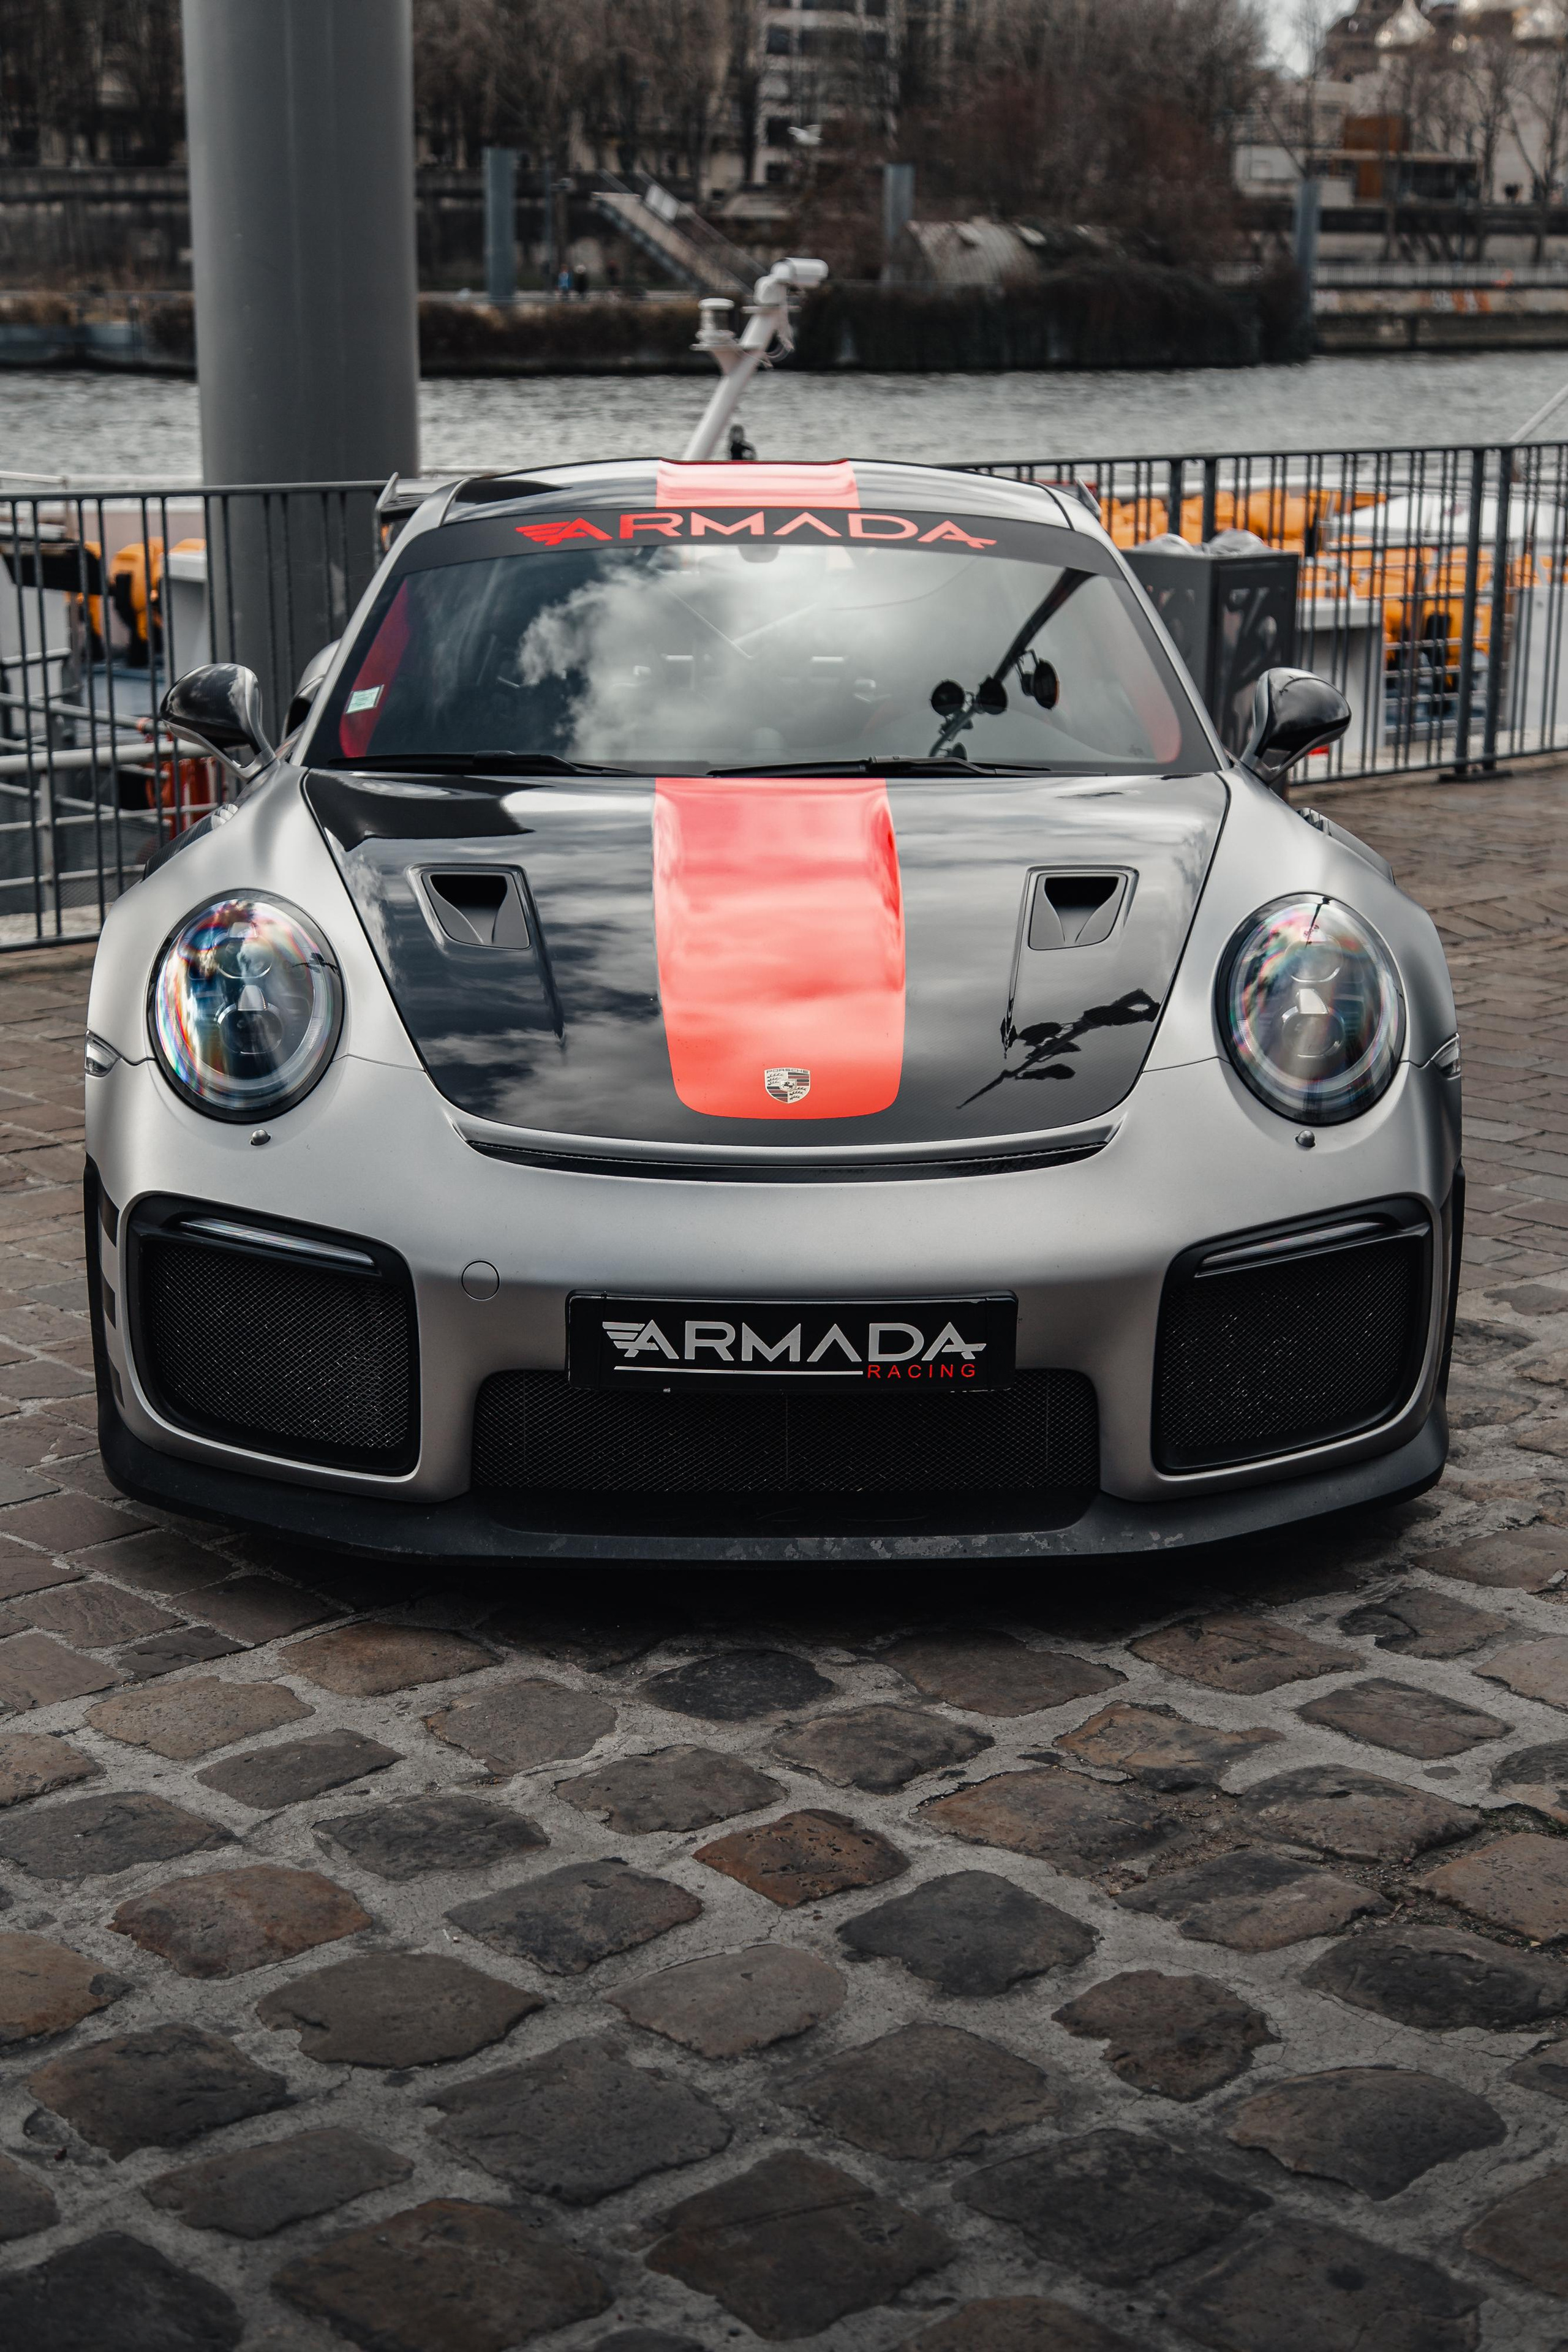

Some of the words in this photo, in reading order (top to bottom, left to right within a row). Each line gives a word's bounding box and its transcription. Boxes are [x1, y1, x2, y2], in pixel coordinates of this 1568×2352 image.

[515, 510, 997, 549] ARMADA
[602, 1319, 987, 1362] ARMADA
[867, 1363, 976, 1379] RACING
